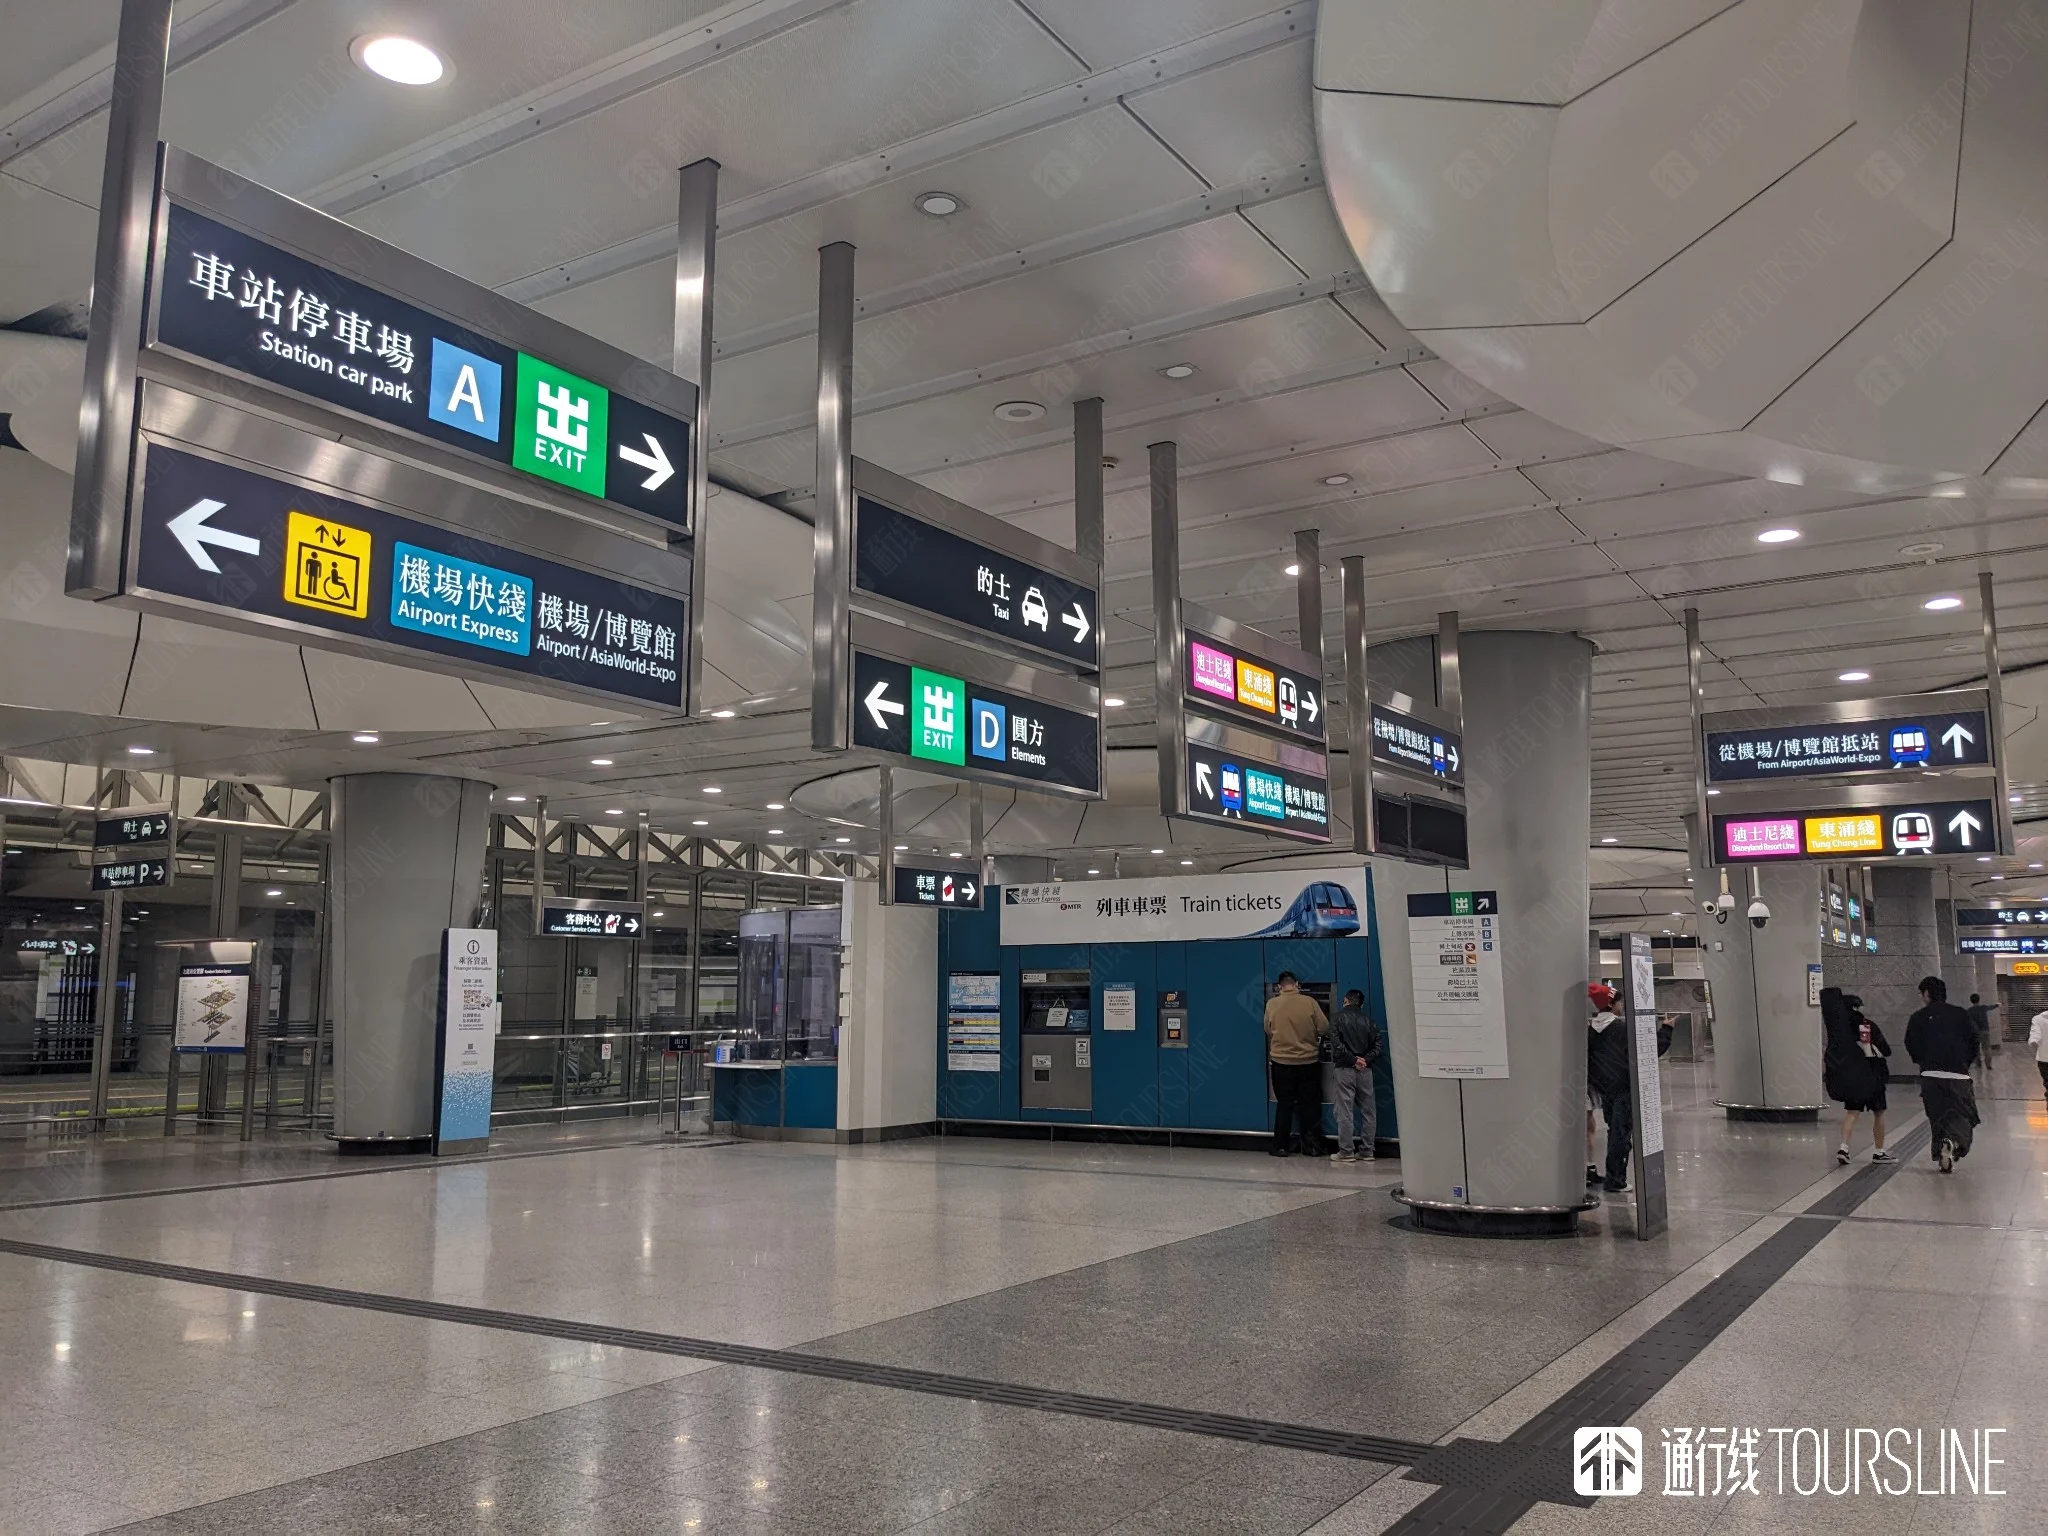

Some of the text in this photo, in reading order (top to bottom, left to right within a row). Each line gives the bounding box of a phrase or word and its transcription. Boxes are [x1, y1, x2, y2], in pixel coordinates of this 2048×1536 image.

[189, 251, 414, 374] 車站停車場
[260, 331, 413, 404] Station car park
[447, 364, 484, 423] A
[536, 380, 589, 452] 出
[534, 437, 588, 473] EXIT
[399, 554, 526, 623] 機場快綫
[977, 565, 1011, 601] 的士
[397, 600, 519, 644] Airport Express
[993, 603, 1010, 621] Taxi
[538, 591, 677, 663] 機場/博覽館
[537, 634, 581, 661] Airport
[590, 647, 677, 683] AsiaWorld-Expo
[1243, 668, 1272, 696] 東涌綫
[1239, 687, 1273, 707] Tung Chung Line
[924, 685, 954, 734] 出
[924, 729, 954, 751] EXIT
[980, 710, 1000, 749] D
[1012, 714, 1044, 747] 圓方
[1011, 747, 1046, 766] Elements
[1718, 732, 1880, 762] 從機場/博覽館抵站
[1757, 761, 1778, 770] From
[1248, 797, 1282, 815] Airport Express
[123, 820, 137, 833] 的士
[1732, 824, 1795, 842] 迪士尼綫
[1818, 819, 1876, 839] 東涌綫
[1731, 842, 1796, 853] Disneyland Resort Line
[1811, 838, 1877, 851] Tung Chung Line
[916, 874, 936, 891] 車票
[918, 892, 936, 901] Tickets
[1096, 896, 1167, 917] 列車車票
[1180, 894, 1282, 913] Train tickets
[1483, 918, 1489, 926] A
[1484, 930, 1490, 938] B
